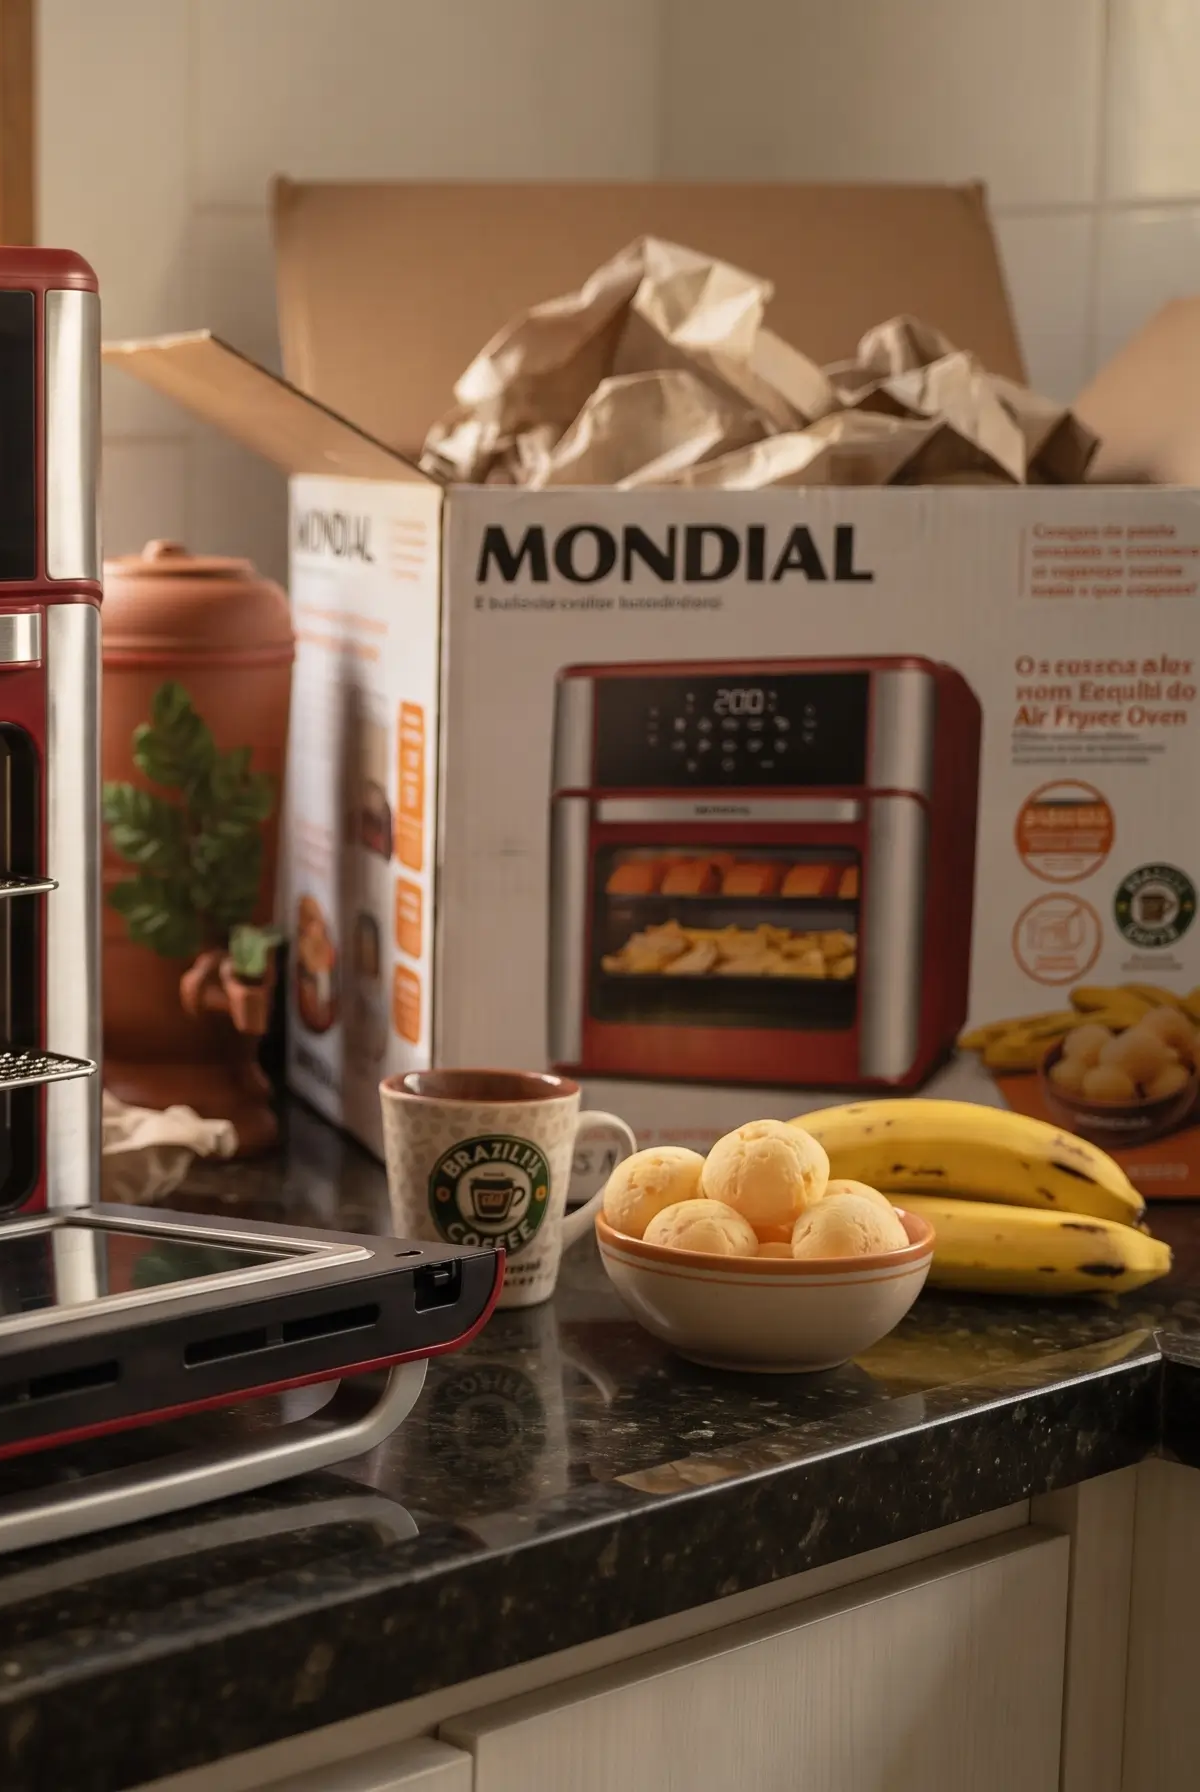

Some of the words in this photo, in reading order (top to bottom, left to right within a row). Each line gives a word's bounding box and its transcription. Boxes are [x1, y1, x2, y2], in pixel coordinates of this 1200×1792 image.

[475, 523, 874, 585] MONDIAL
[713, 688, 764, 715] 200
[1127, 705, 1188, 727] Oven
